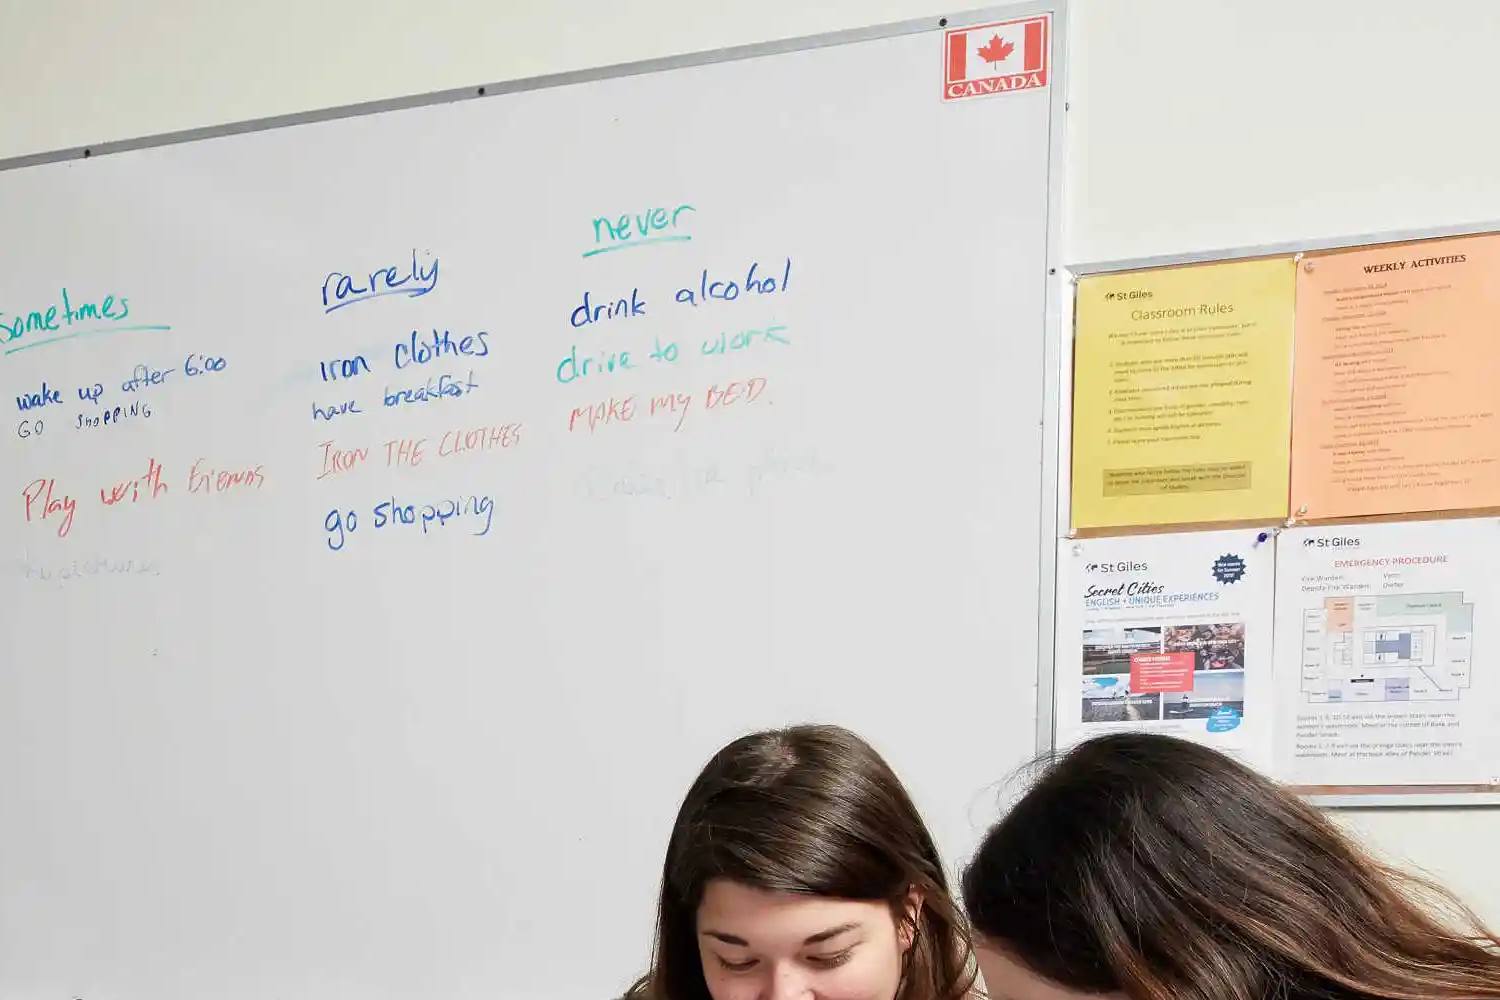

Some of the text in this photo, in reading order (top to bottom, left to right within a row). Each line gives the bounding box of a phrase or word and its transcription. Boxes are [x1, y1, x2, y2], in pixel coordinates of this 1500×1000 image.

[948, 73, 1042, 98] CANADA
[592, 204, 696, 242] never
[322, 248, 439, 306] rarely
[1364, 254, 1467, 275] WEEKLY ACTIVITIES
[570, 256, 791, 328] drink alcohol
[1117, 289, 1153, 301] St Giles
[1131, 302, 1235, 321] Classroom Rules
[395, 328, 489, 370] clothes
[556, 324, 790, 383] drive to work
[16, 353, 227, 411] wake up after 6:00
[312, 370, 480, 422] have breakfast
[17, 418, 44, 439] GO
[569, 396, 637, 434] MAKE
[385, 438, 428, 467] THE
[439, 423, 523, 457] CLOTHES
[22, 478, 77, 538] Play
[100, 457, 168, 505] with
[325, 495, 495, 551] go shopping
[1317, 537, 1360, 547] St Giles
[1100, 561, 1148, 573] St Giles
[1334, 555, 1448, 568] EMERGENCY PROCEDURE
[1084, 580, 1164, 598] Secret Cities
[1085, 598, 1120, 607] ENGLISH
[1129, 596, 1161, 605] UNIQUE
[1163, 592, 1220, 604] EXPERIENCES
